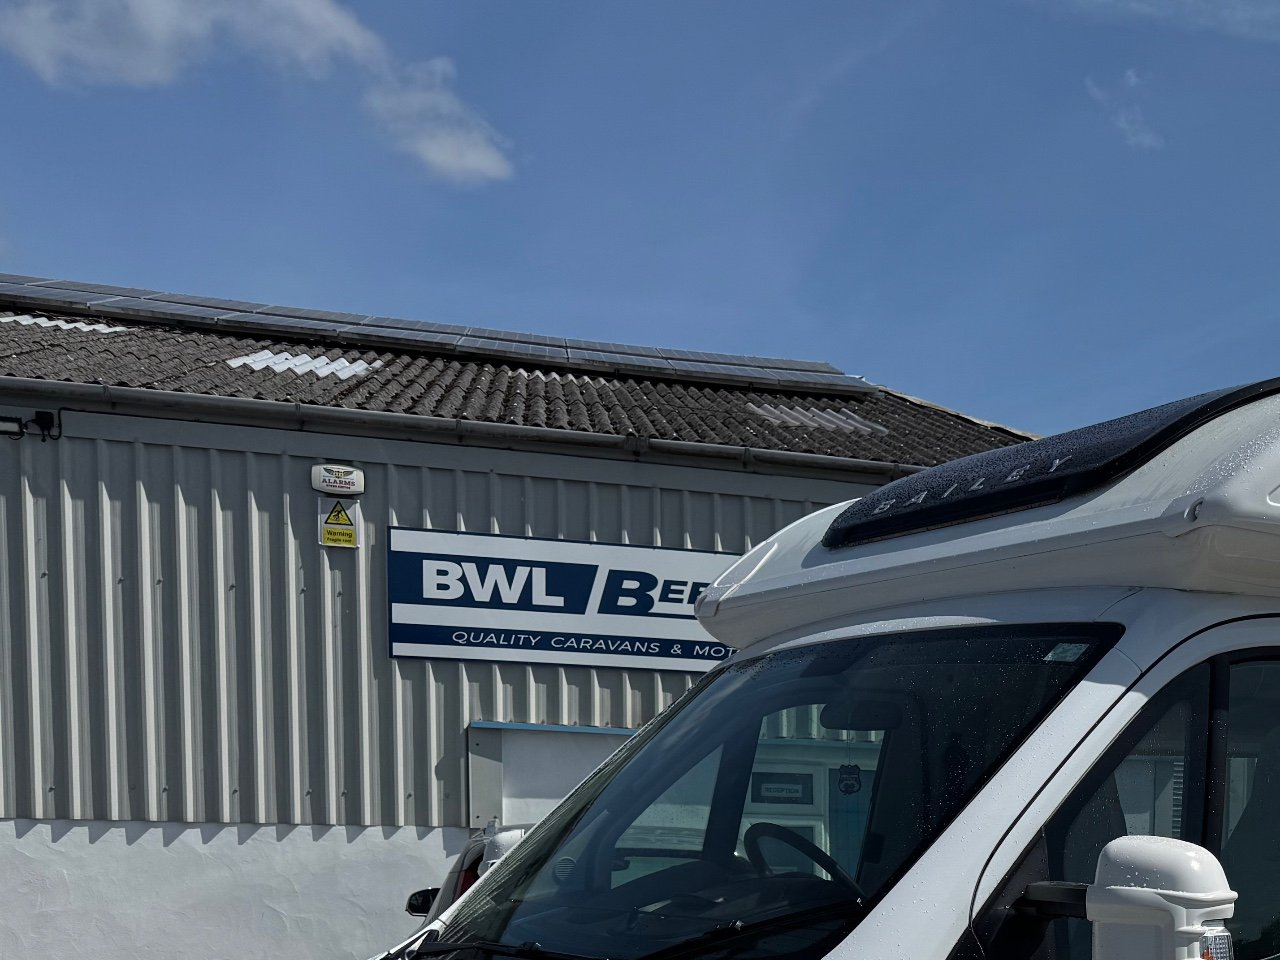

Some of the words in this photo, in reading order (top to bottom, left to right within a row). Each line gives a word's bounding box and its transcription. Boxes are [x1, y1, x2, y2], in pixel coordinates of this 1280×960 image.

[322, 478, 356, 487] ALARMS
[326, 530, 353, 538] Warning
[422, 560, 564, 607] BWL
[452, 631, 541, 646] QUALITY
[551, 636, 661, 654] CARAVANS
[670, 644, 682, 654] &
[693, 645, 740, 658] MOT
